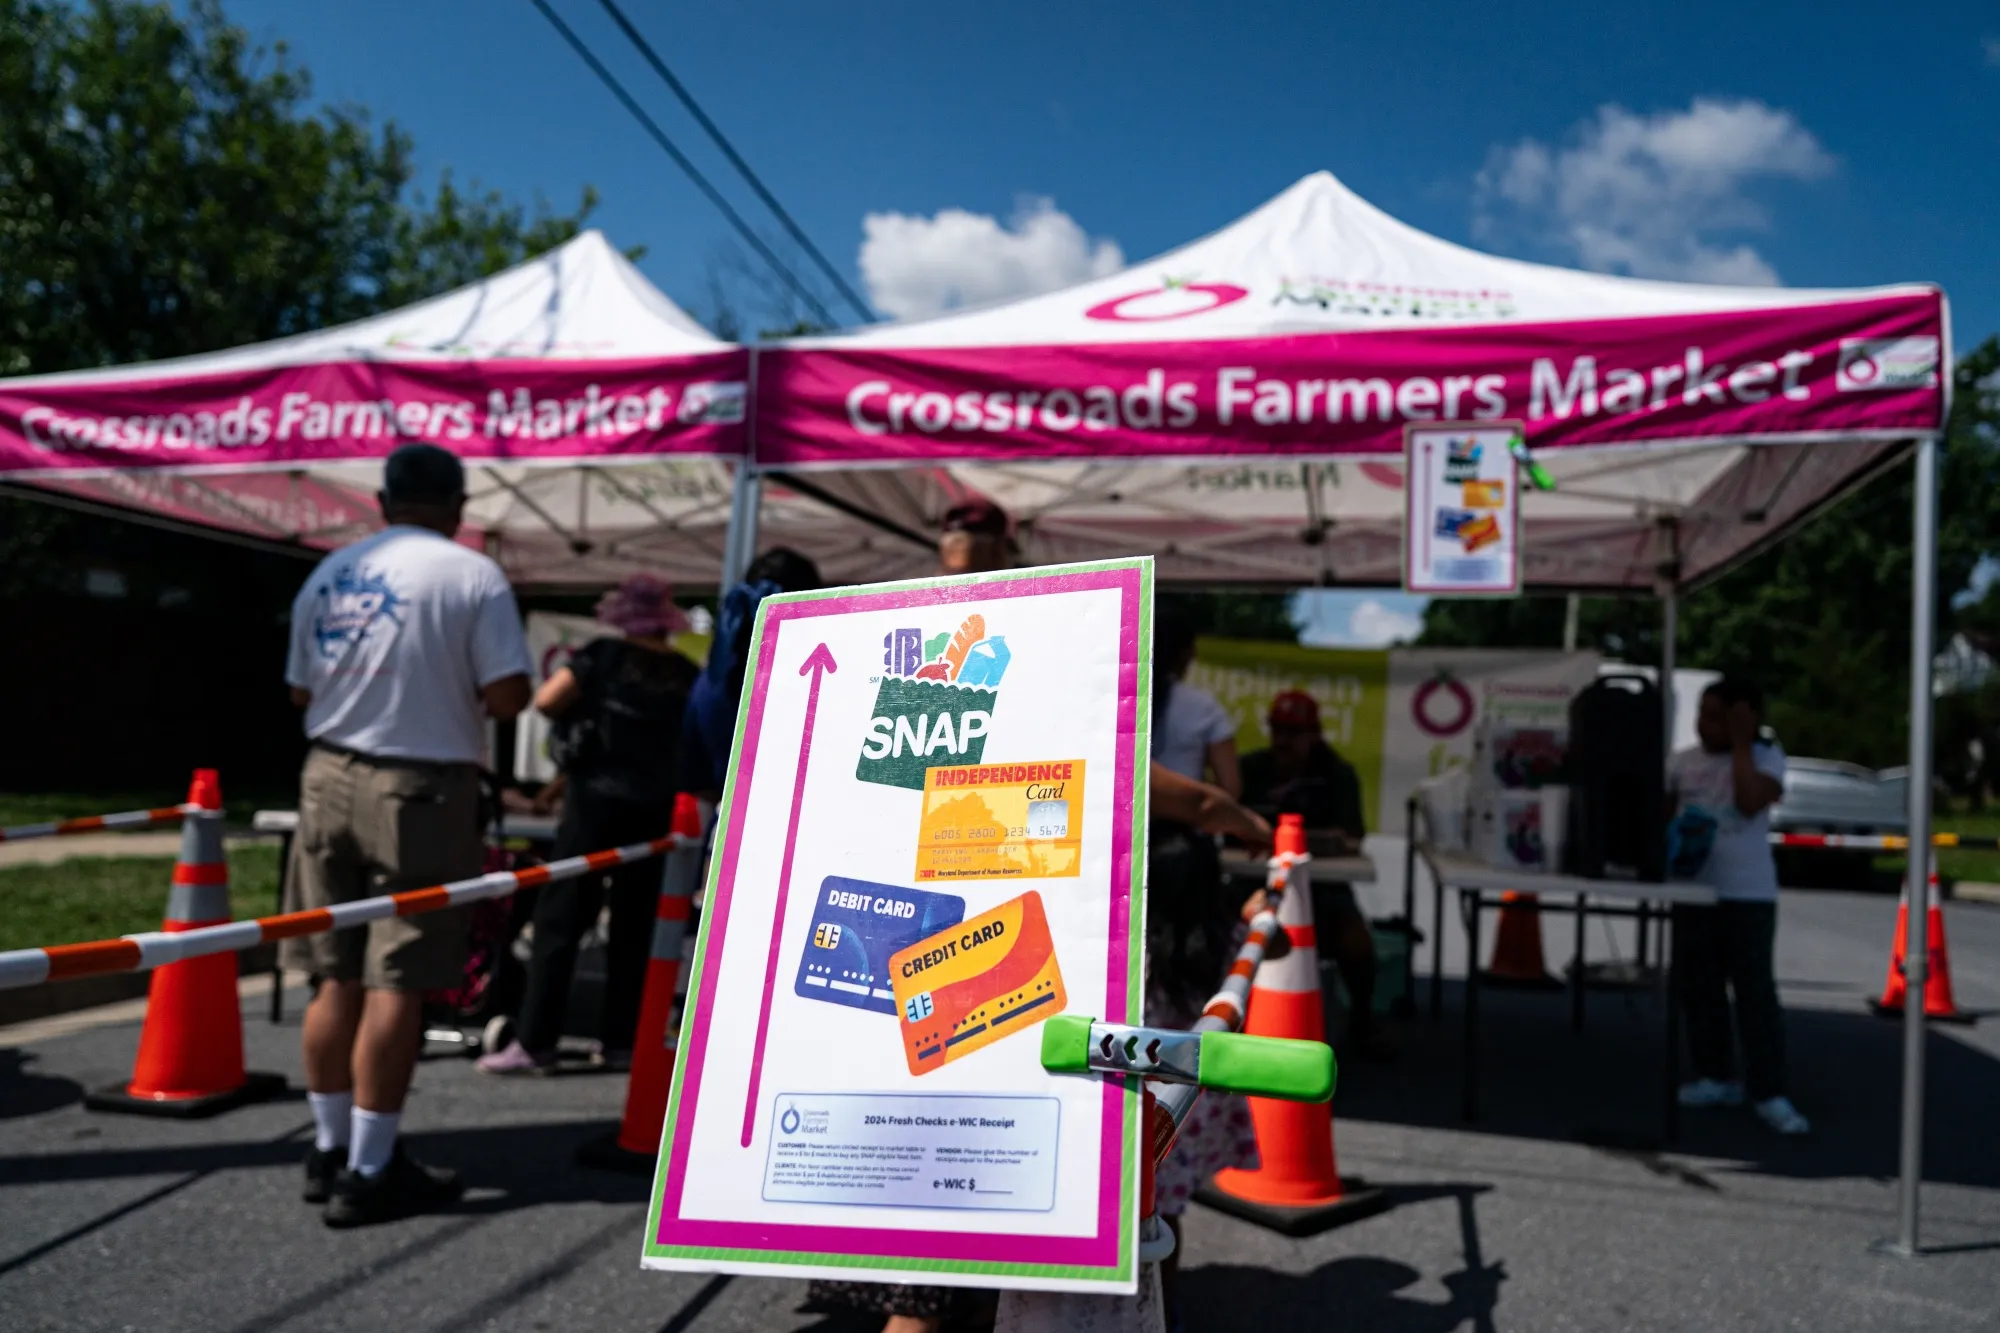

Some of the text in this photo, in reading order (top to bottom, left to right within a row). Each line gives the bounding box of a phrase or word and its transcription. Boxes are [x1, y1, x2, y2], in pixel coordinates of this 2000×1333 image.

[845, 368, 1197, 435] Crossroads
[1217, 366, 1506, 422] Farmers
[1527, 347, 1814, 420] Market
[20, 383, 670, 452] Crossroads Farmers Market
[863, 709, 992, 760] SNAP
[935, 763, 1073, 786] INDEPENDENCE
[1026, 783, 1065, 799] Card
[934, 826, 1067, 840] 6005 2800 1234 5678
[828, 890, 916, 919] DEBIT CARD
[902, 920, 1005, 978] CREDIT CARD
[802, 1125, 828, 1134] Market
[864, 1116, 1015, 1128] 2024 Fresh Checks e-WIC Receipt
[933, 1177, 975, 1191] e-WIC $
